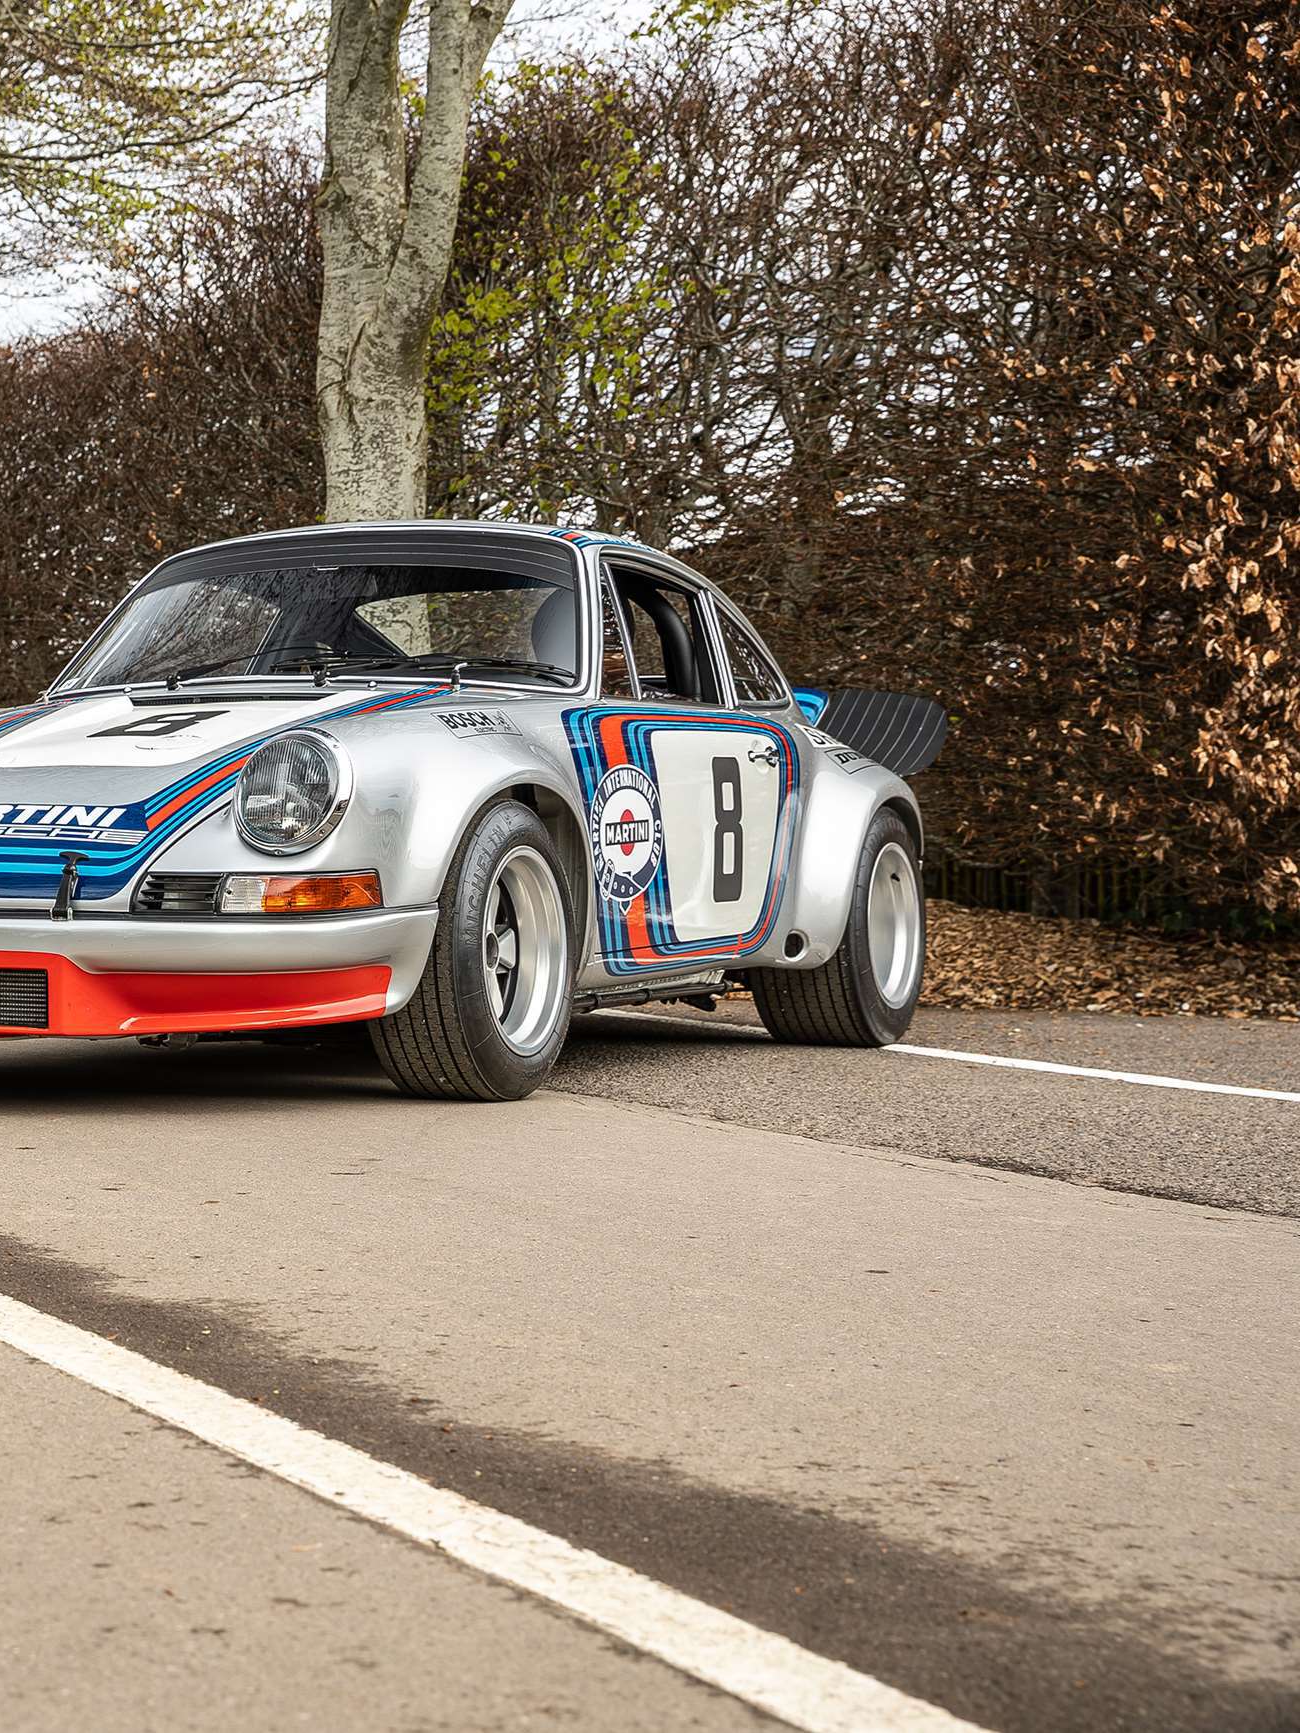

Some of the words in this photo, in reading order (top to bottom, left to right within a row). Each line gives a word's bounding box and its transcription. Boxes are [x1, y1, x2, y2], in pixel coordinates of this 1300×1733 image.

[436, 711, 496, 729] BOSCH
[603, 769, 657, 809] INTERNATIONAL
[650, 819, 662, 868] CLUB
[606, 820, 649, 845] MARTINI
[712, 757, 743, 903] 8
[465, 824, 508, 946] MICHELIN
